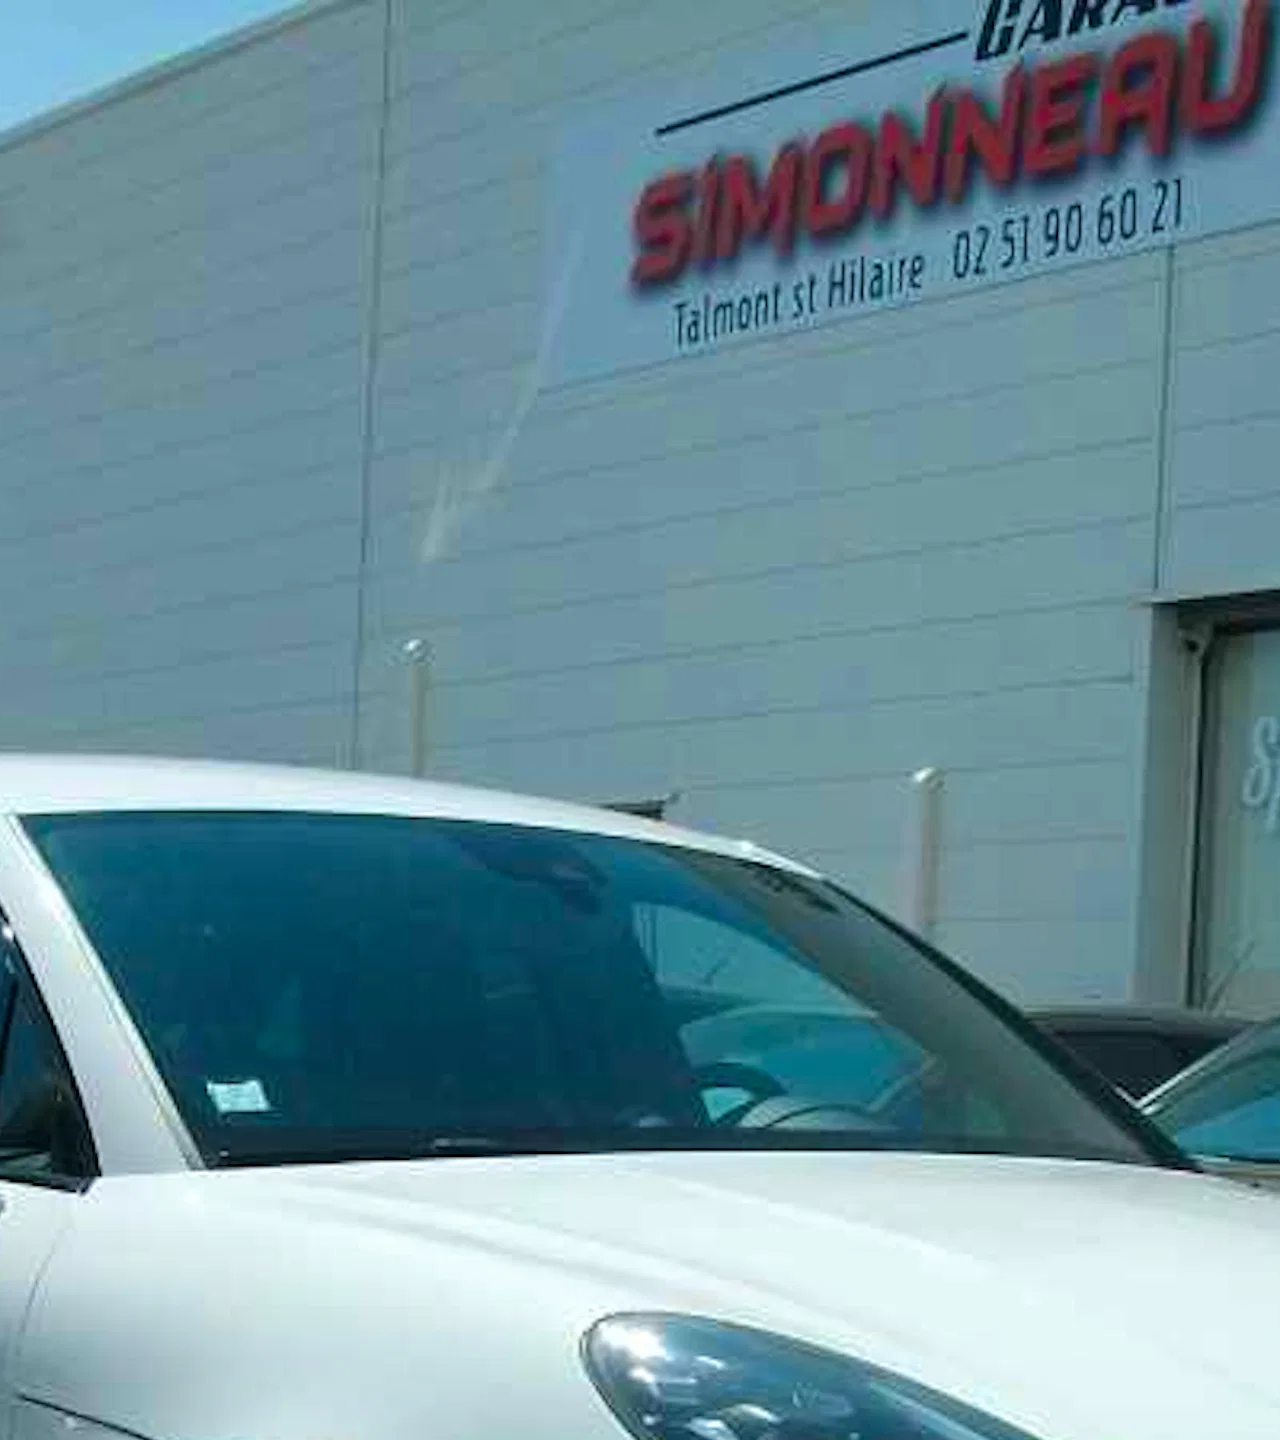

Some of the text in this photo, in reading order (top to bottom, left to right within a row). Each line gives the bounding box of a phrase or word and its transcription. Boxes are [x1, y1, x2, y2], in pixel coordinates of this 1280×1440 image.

[628, 0, 1273, 286] SIMONNEAU
[674, 178, 1183, 347] Talmont st Hilaire 02 51 90 60 21
